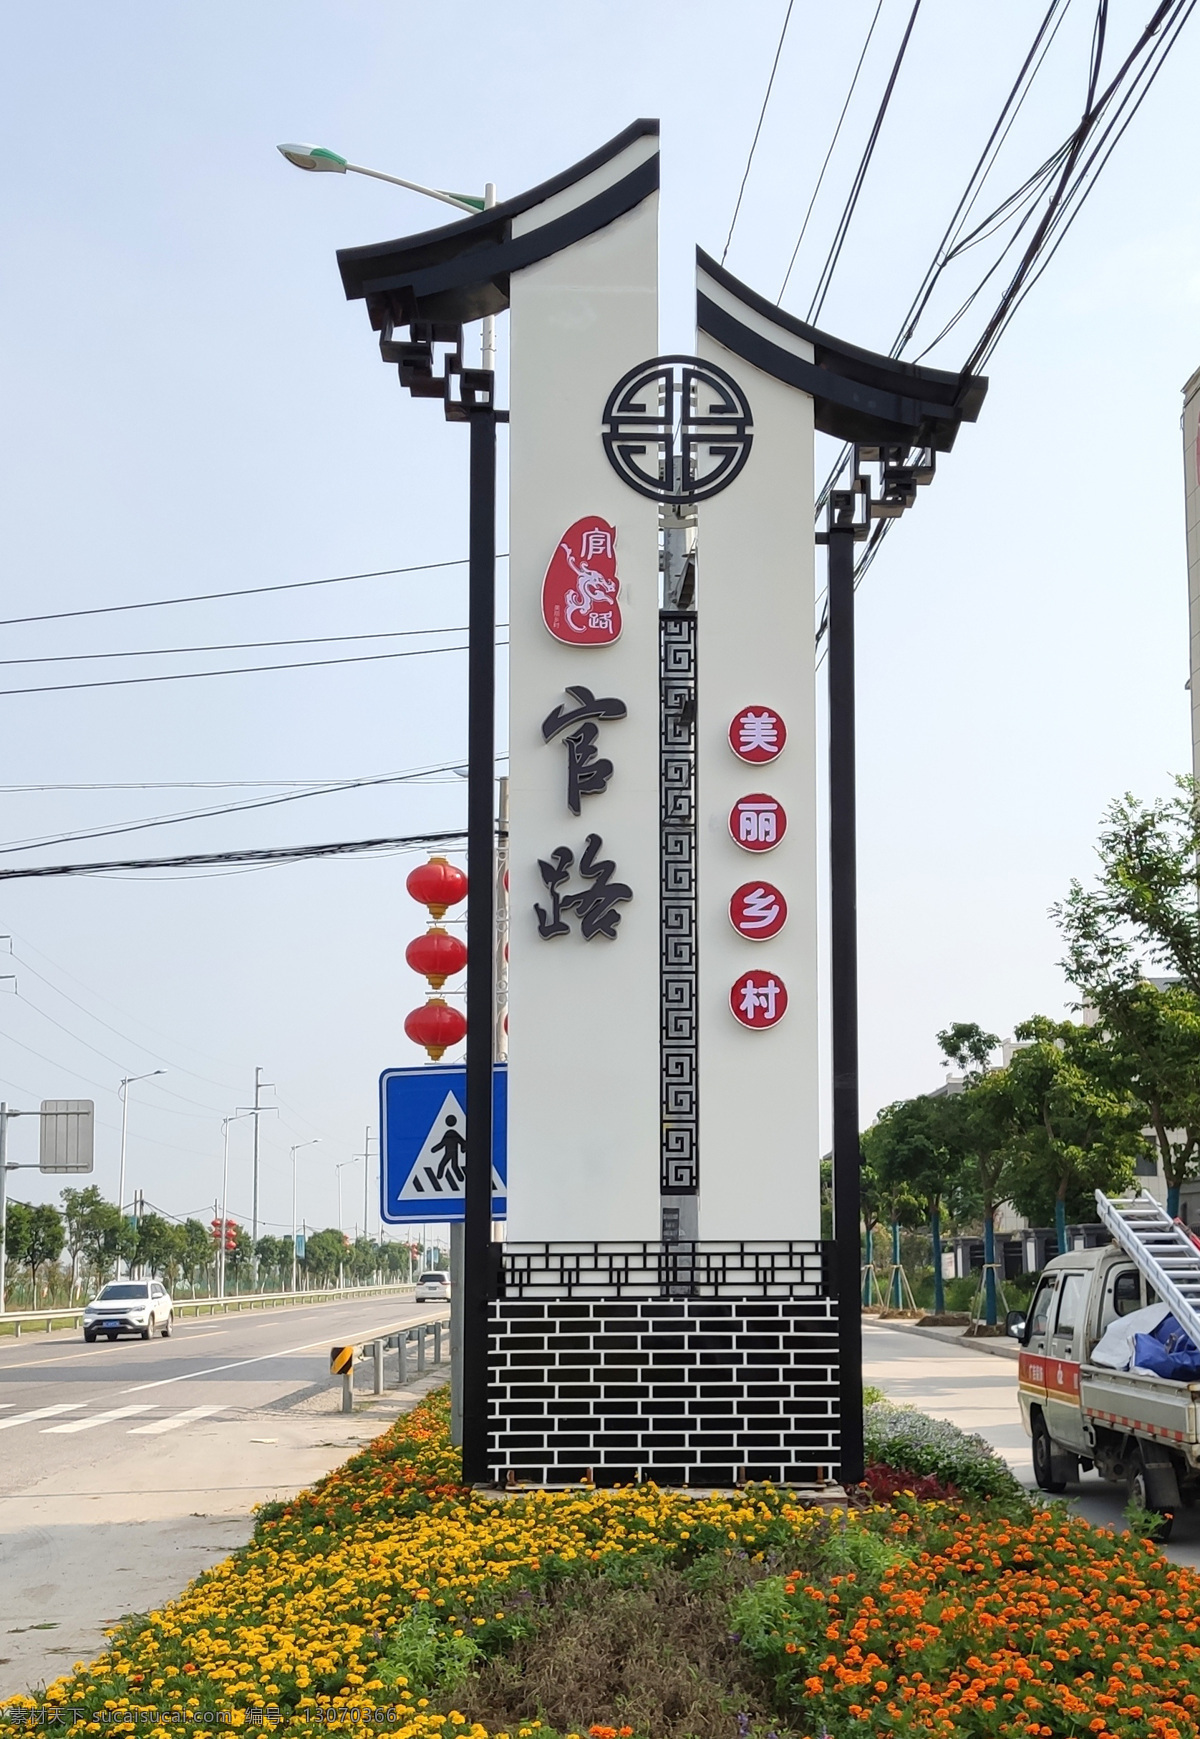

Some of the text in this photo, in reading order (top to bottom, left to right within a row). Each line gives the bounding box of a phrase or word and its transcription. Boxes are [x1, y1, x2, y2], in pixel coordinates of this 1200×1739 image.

[533, 685, 633, 941] 官路
[738, 711, 780, 1020] 美丽乡村
